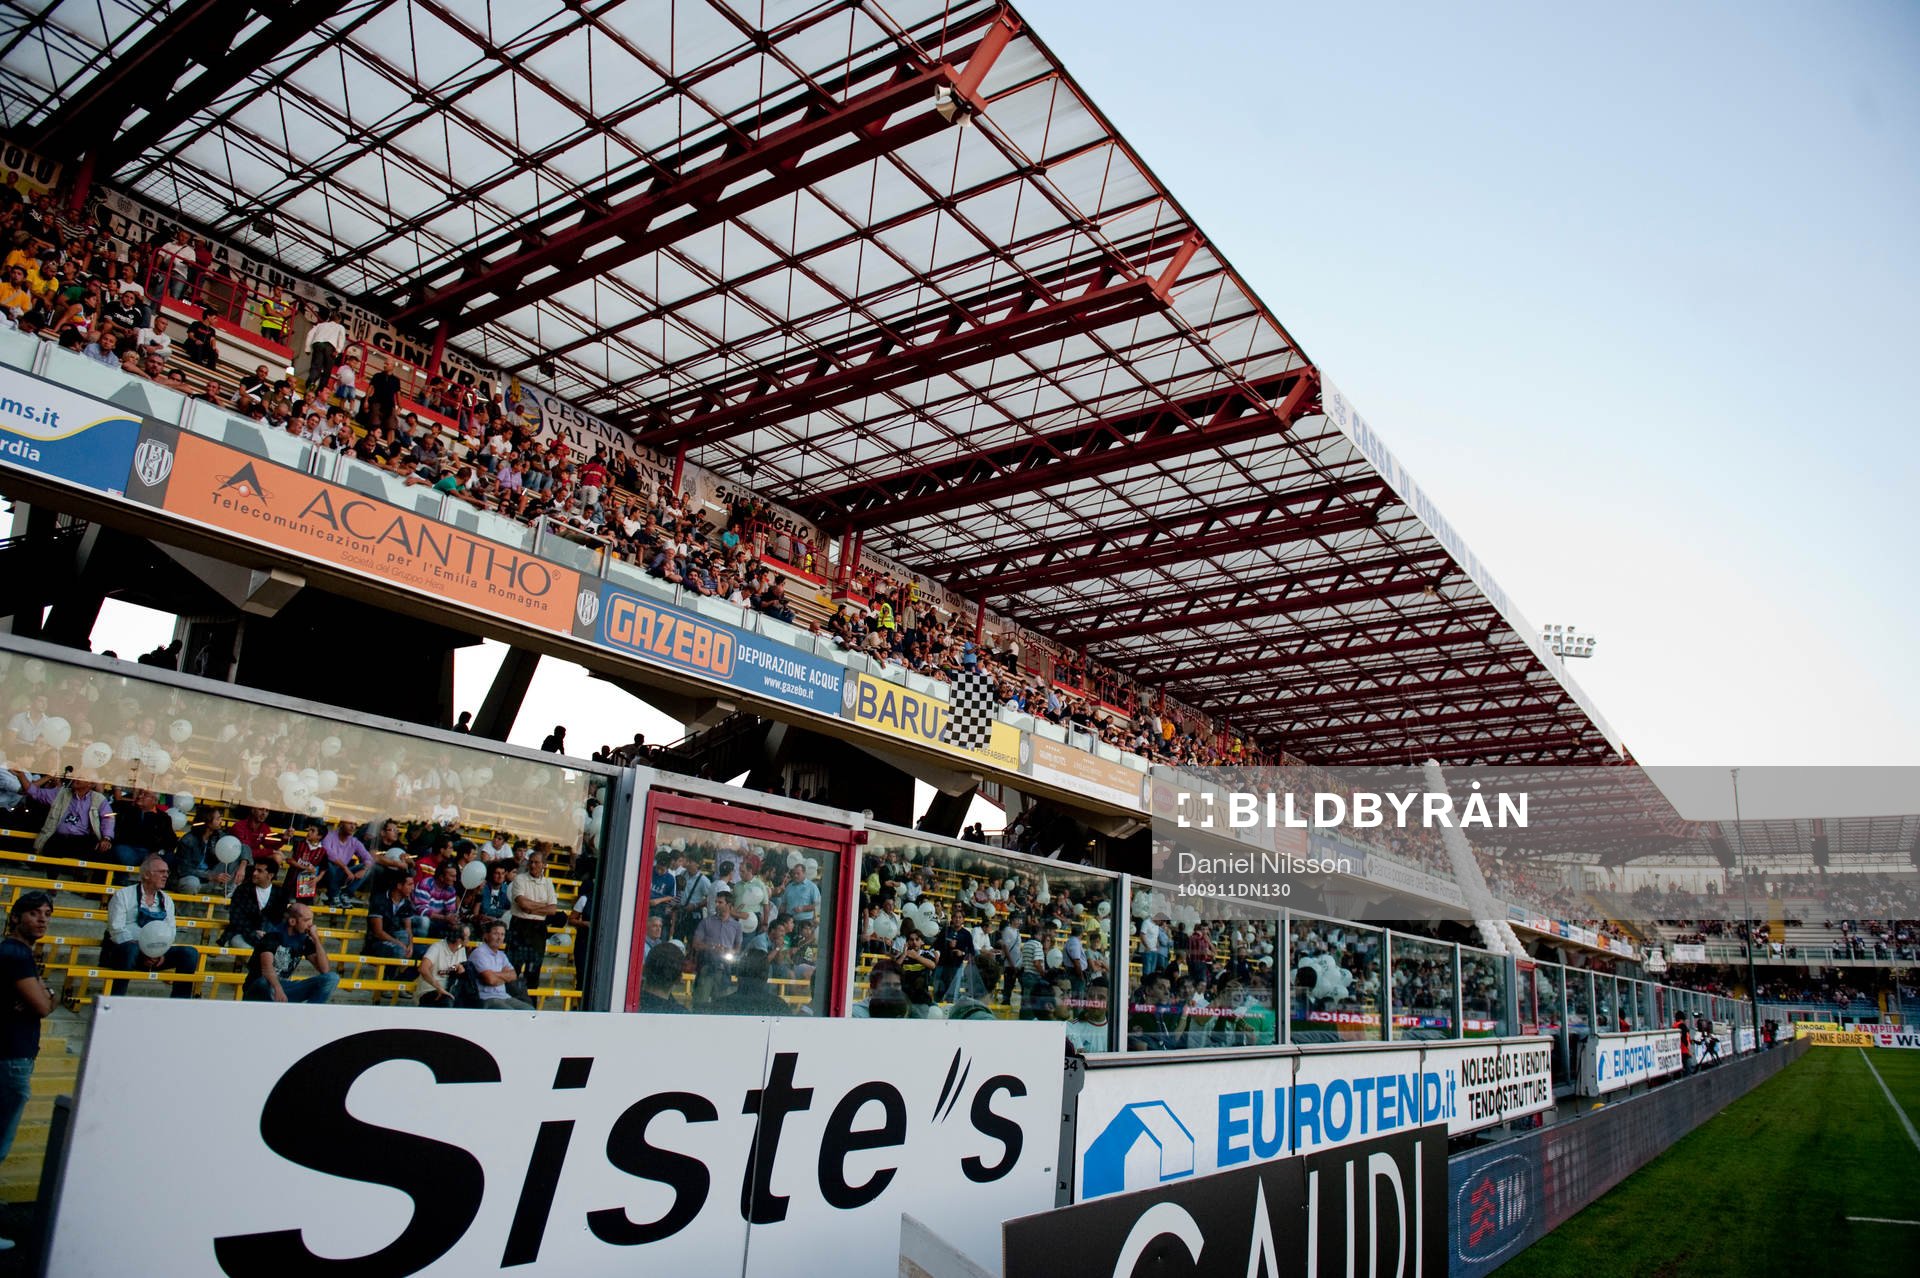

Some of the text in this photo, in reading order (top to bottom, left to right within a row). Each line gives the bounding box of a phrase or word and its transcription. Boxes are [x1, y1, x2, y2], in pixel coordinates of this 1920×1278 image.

[544, 397, 626, 448] CESENA
[549, 418, 588, 449] VAL
[1353, 411, 1393, 483] CASSA
[1399, 465, 1411, 504] DI
[211, 492, 548, 611] Telecomunicazioni per l'Emilia Romagna
[297, 489, 551, 597] ACANTHO
[610, 598, 732, 675] GAZEBO
[738, 644, 840, 693] DEPURAZIONE ACQUE
[764, 675, 814, 701] www.gazebo.it
[1461, 1050, 1550, 1088] NOLEGGIO E VENDITA
[1216, 1068, 1456, 1168] EUROTEND.it
[1468, 1078, 1548, 1122] TENDOSTRUTTURE
[1494, 1170, 1527, 1233] TIM
